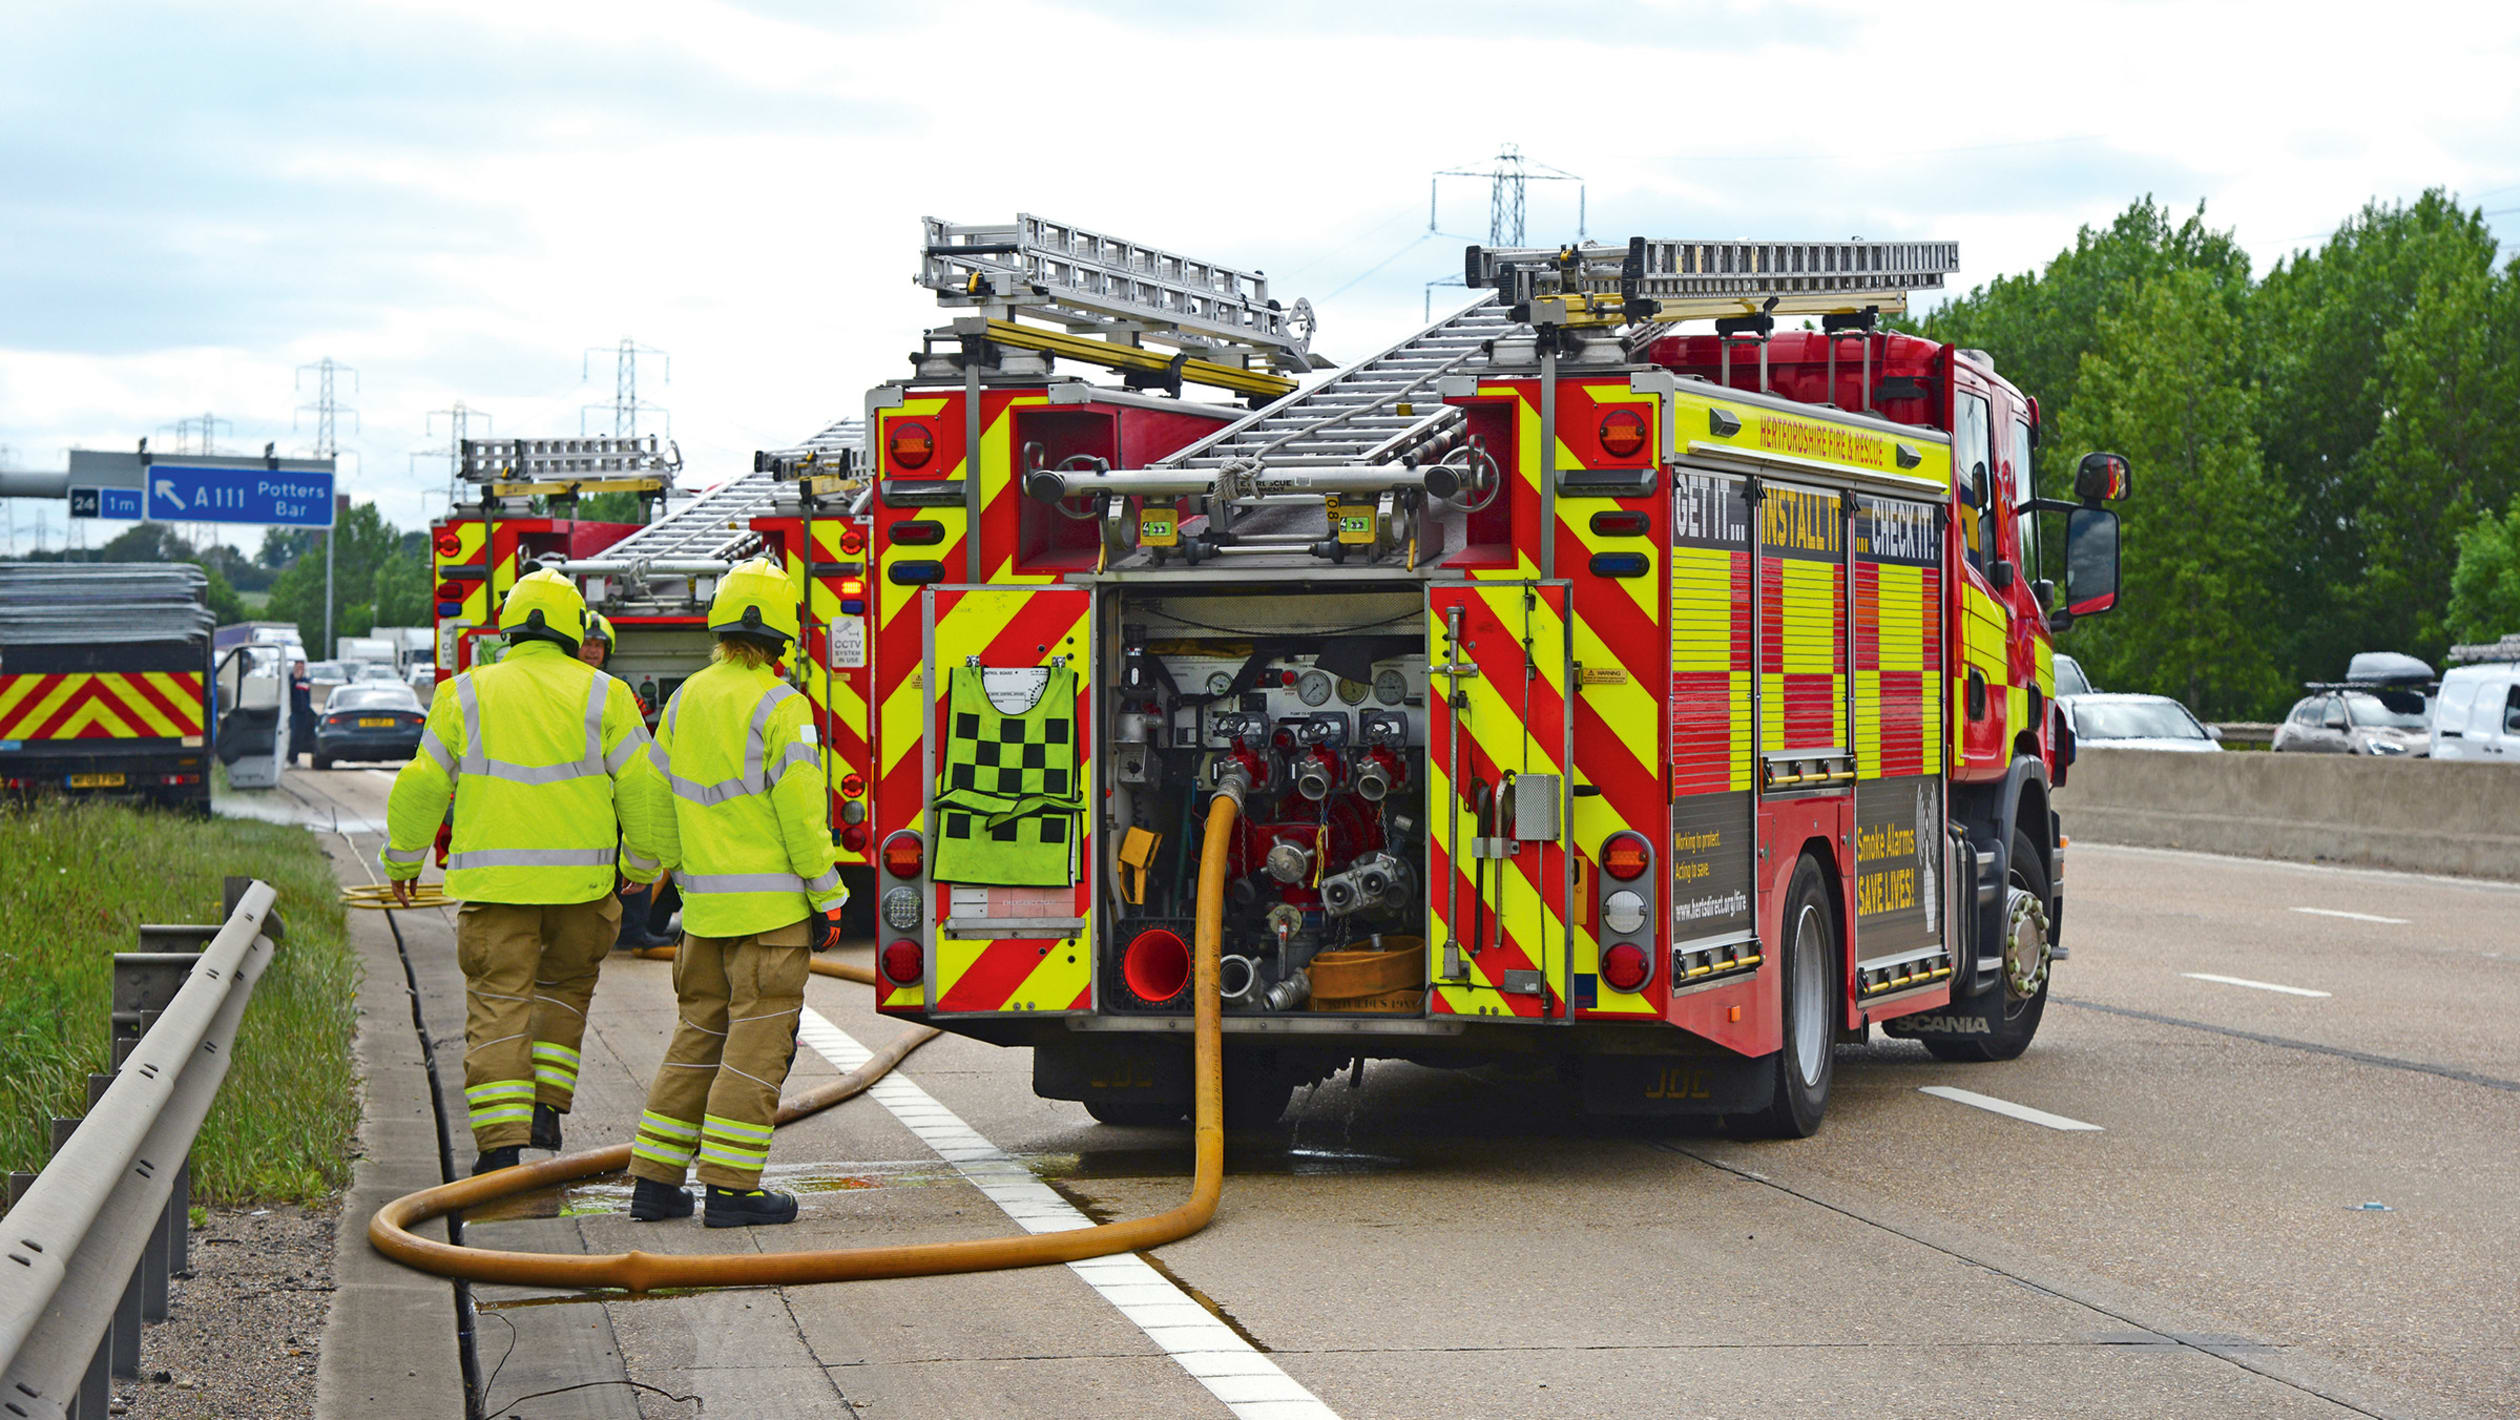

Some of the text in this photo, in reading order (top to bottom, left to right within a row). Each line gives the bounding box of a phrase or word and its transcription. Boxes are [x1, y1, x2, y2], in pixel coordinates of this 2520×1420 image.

[1760, 415, 1883, 466] HERTFORDSHIRE FIRE & RESCUE
[75, 497, 96, 511] 24
[258, 481, 325, 499] Potters
[275, 501, 307, 517] Bar
[1676, 474, 1710, 537] GET
[1761, 484, 1842, 553] INSTALL IT
[1872, 499, 1915, 558] CHECK
[1918, 504, 1934, 560] IT!
[834, 640, 861, 649] CCTV
[1675, 831, 1696, 854] Working
[1697, 831, 1701, 849] to
[1858, 823, 1914, 861] Smoke Alarms
[1675, 861, 1691, 884] Acting
[1692, 861, 1697, 878] to
[1675, 888, 1746, 922] www.hertsdirect.org/fire
[1858, 867, 1914, 916] SAVE LIVES!
[1896, 1014, 1991, 1034] SCANIA
